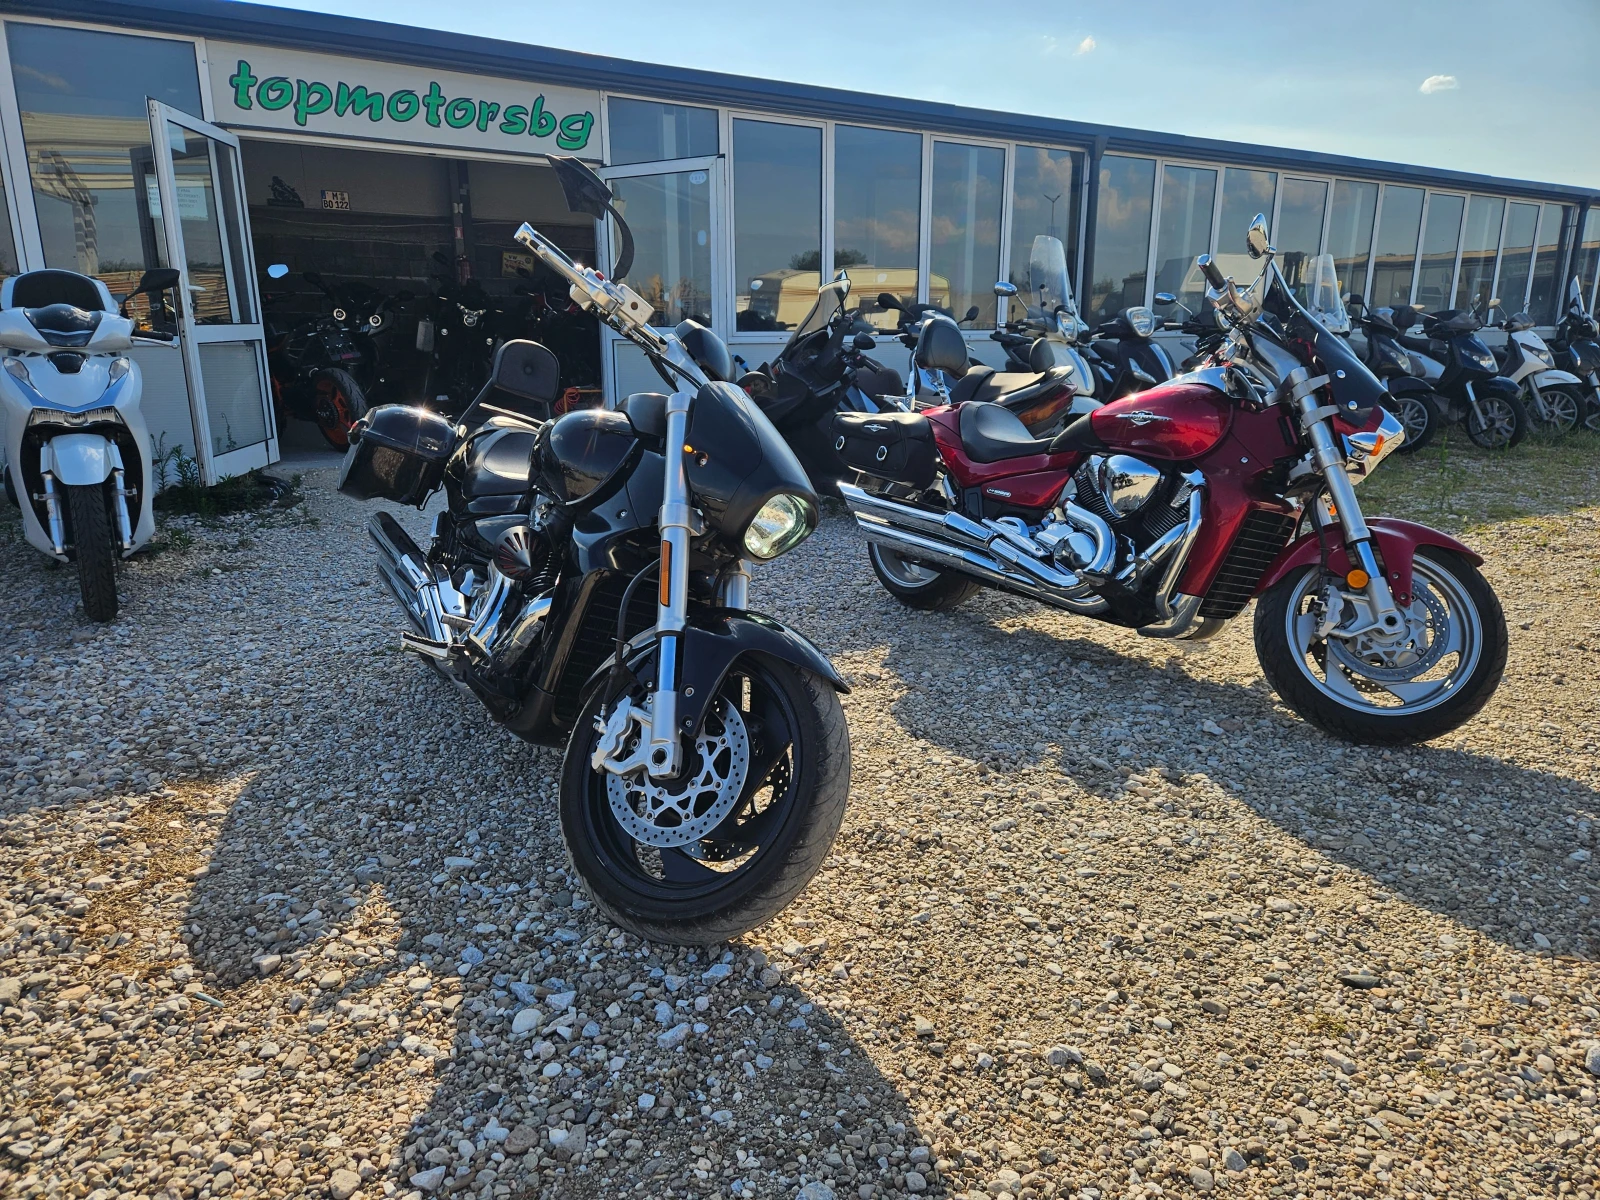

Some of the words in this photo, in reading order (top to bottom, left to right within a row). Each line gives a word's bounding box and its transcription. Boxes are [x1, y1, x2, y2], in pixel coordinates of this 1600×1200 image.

[229, 60, 594, 150] topmotorsbg
[332, 192, 338, 200] M
[335, 201, 349, 209] 122
